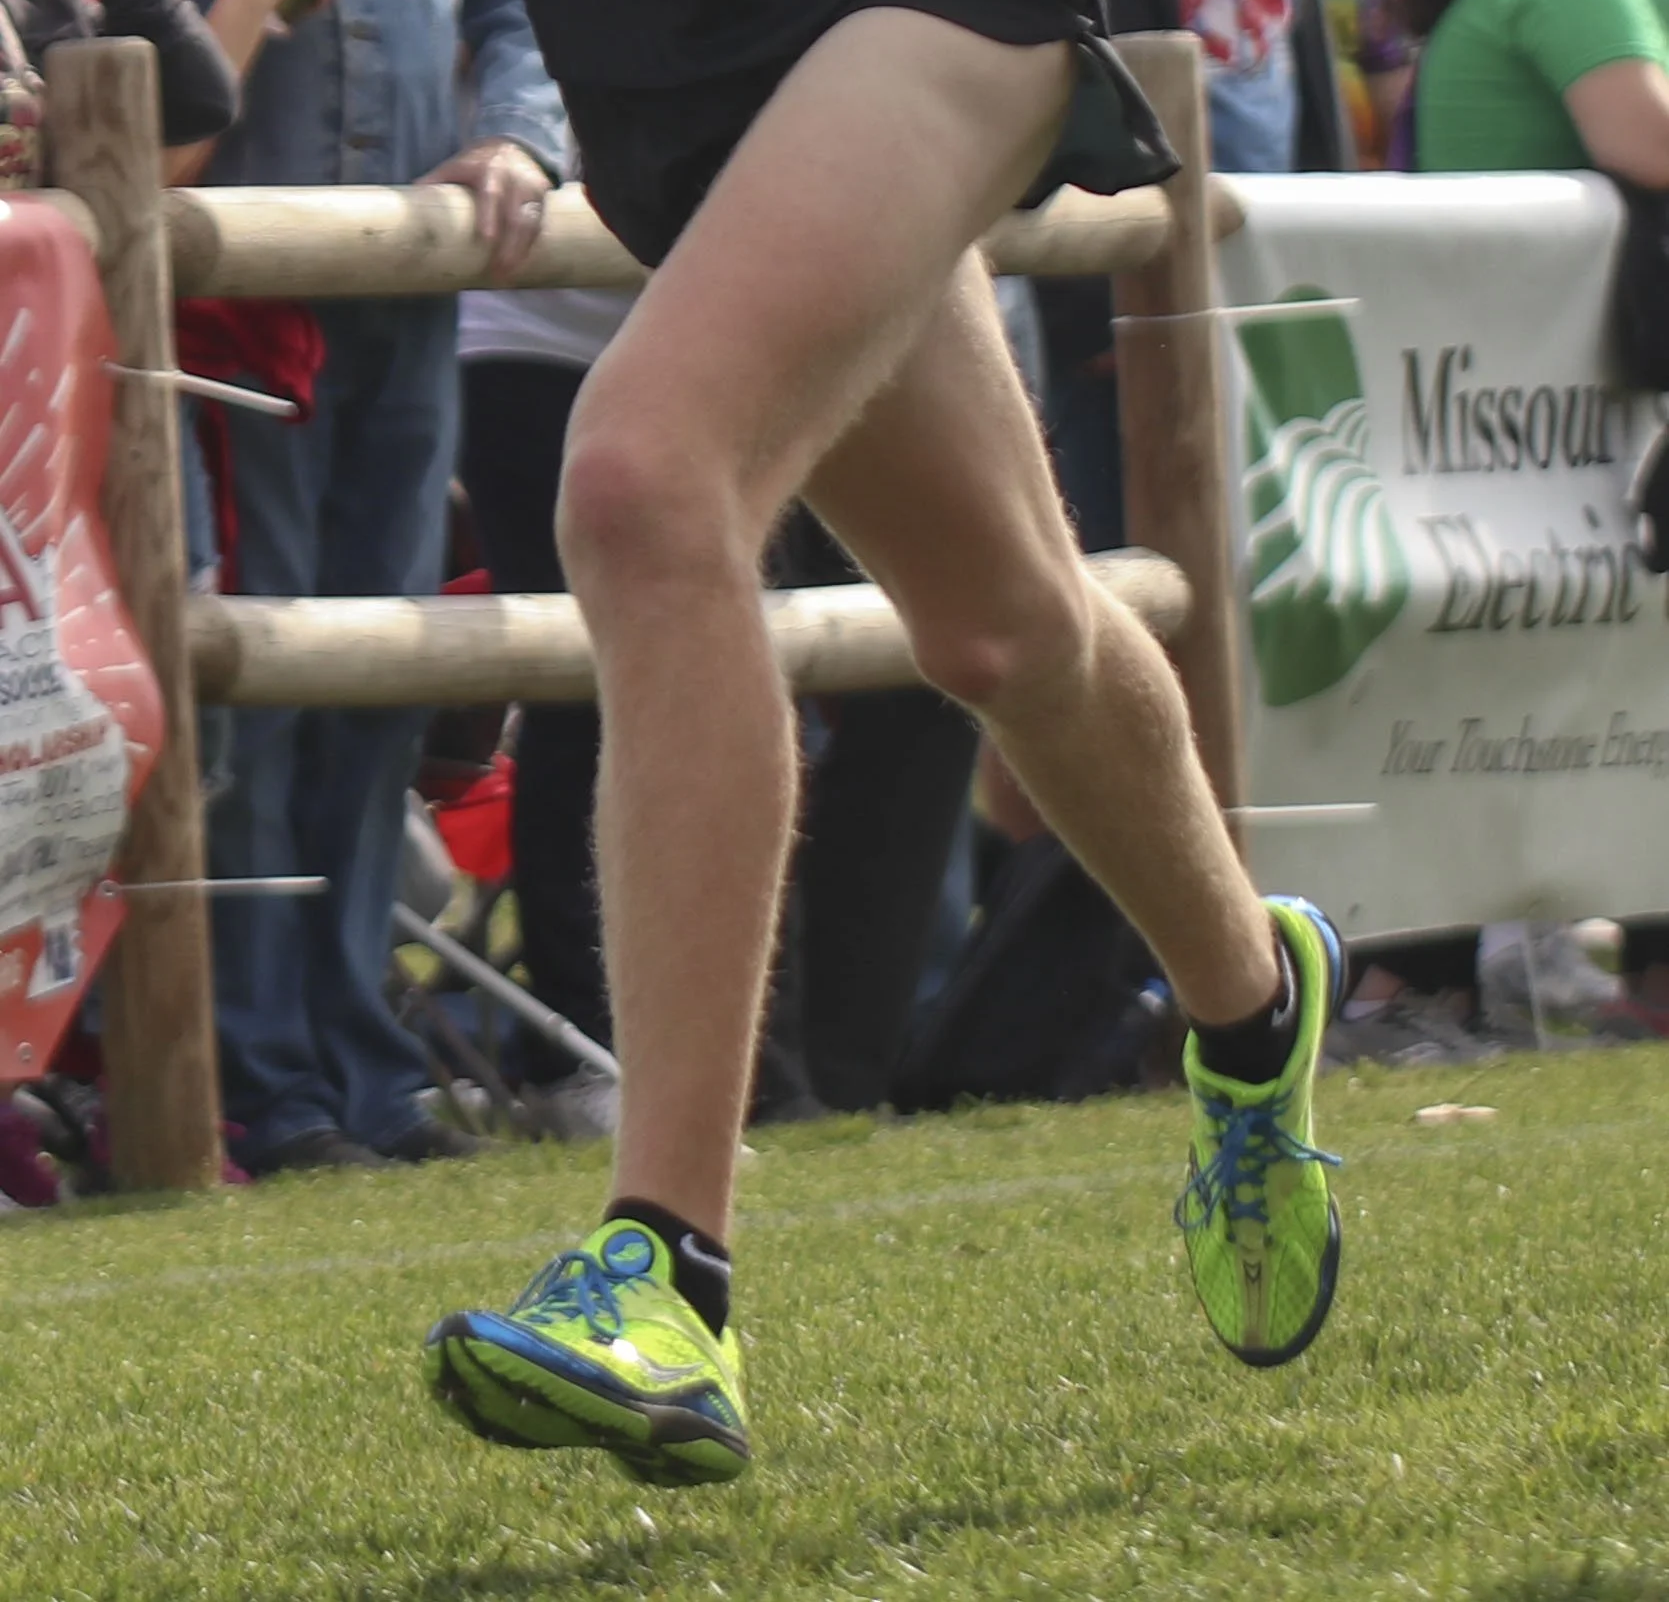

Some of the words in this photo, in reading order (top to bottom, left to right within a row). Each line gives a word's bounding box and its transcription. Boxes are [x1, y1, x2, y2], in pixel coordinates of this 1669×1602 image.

[1416, 503, 1642, 633] Electric
[1379, 718, 1446, 776] Your
[1449, 713, 1597, 774] Touchstone
